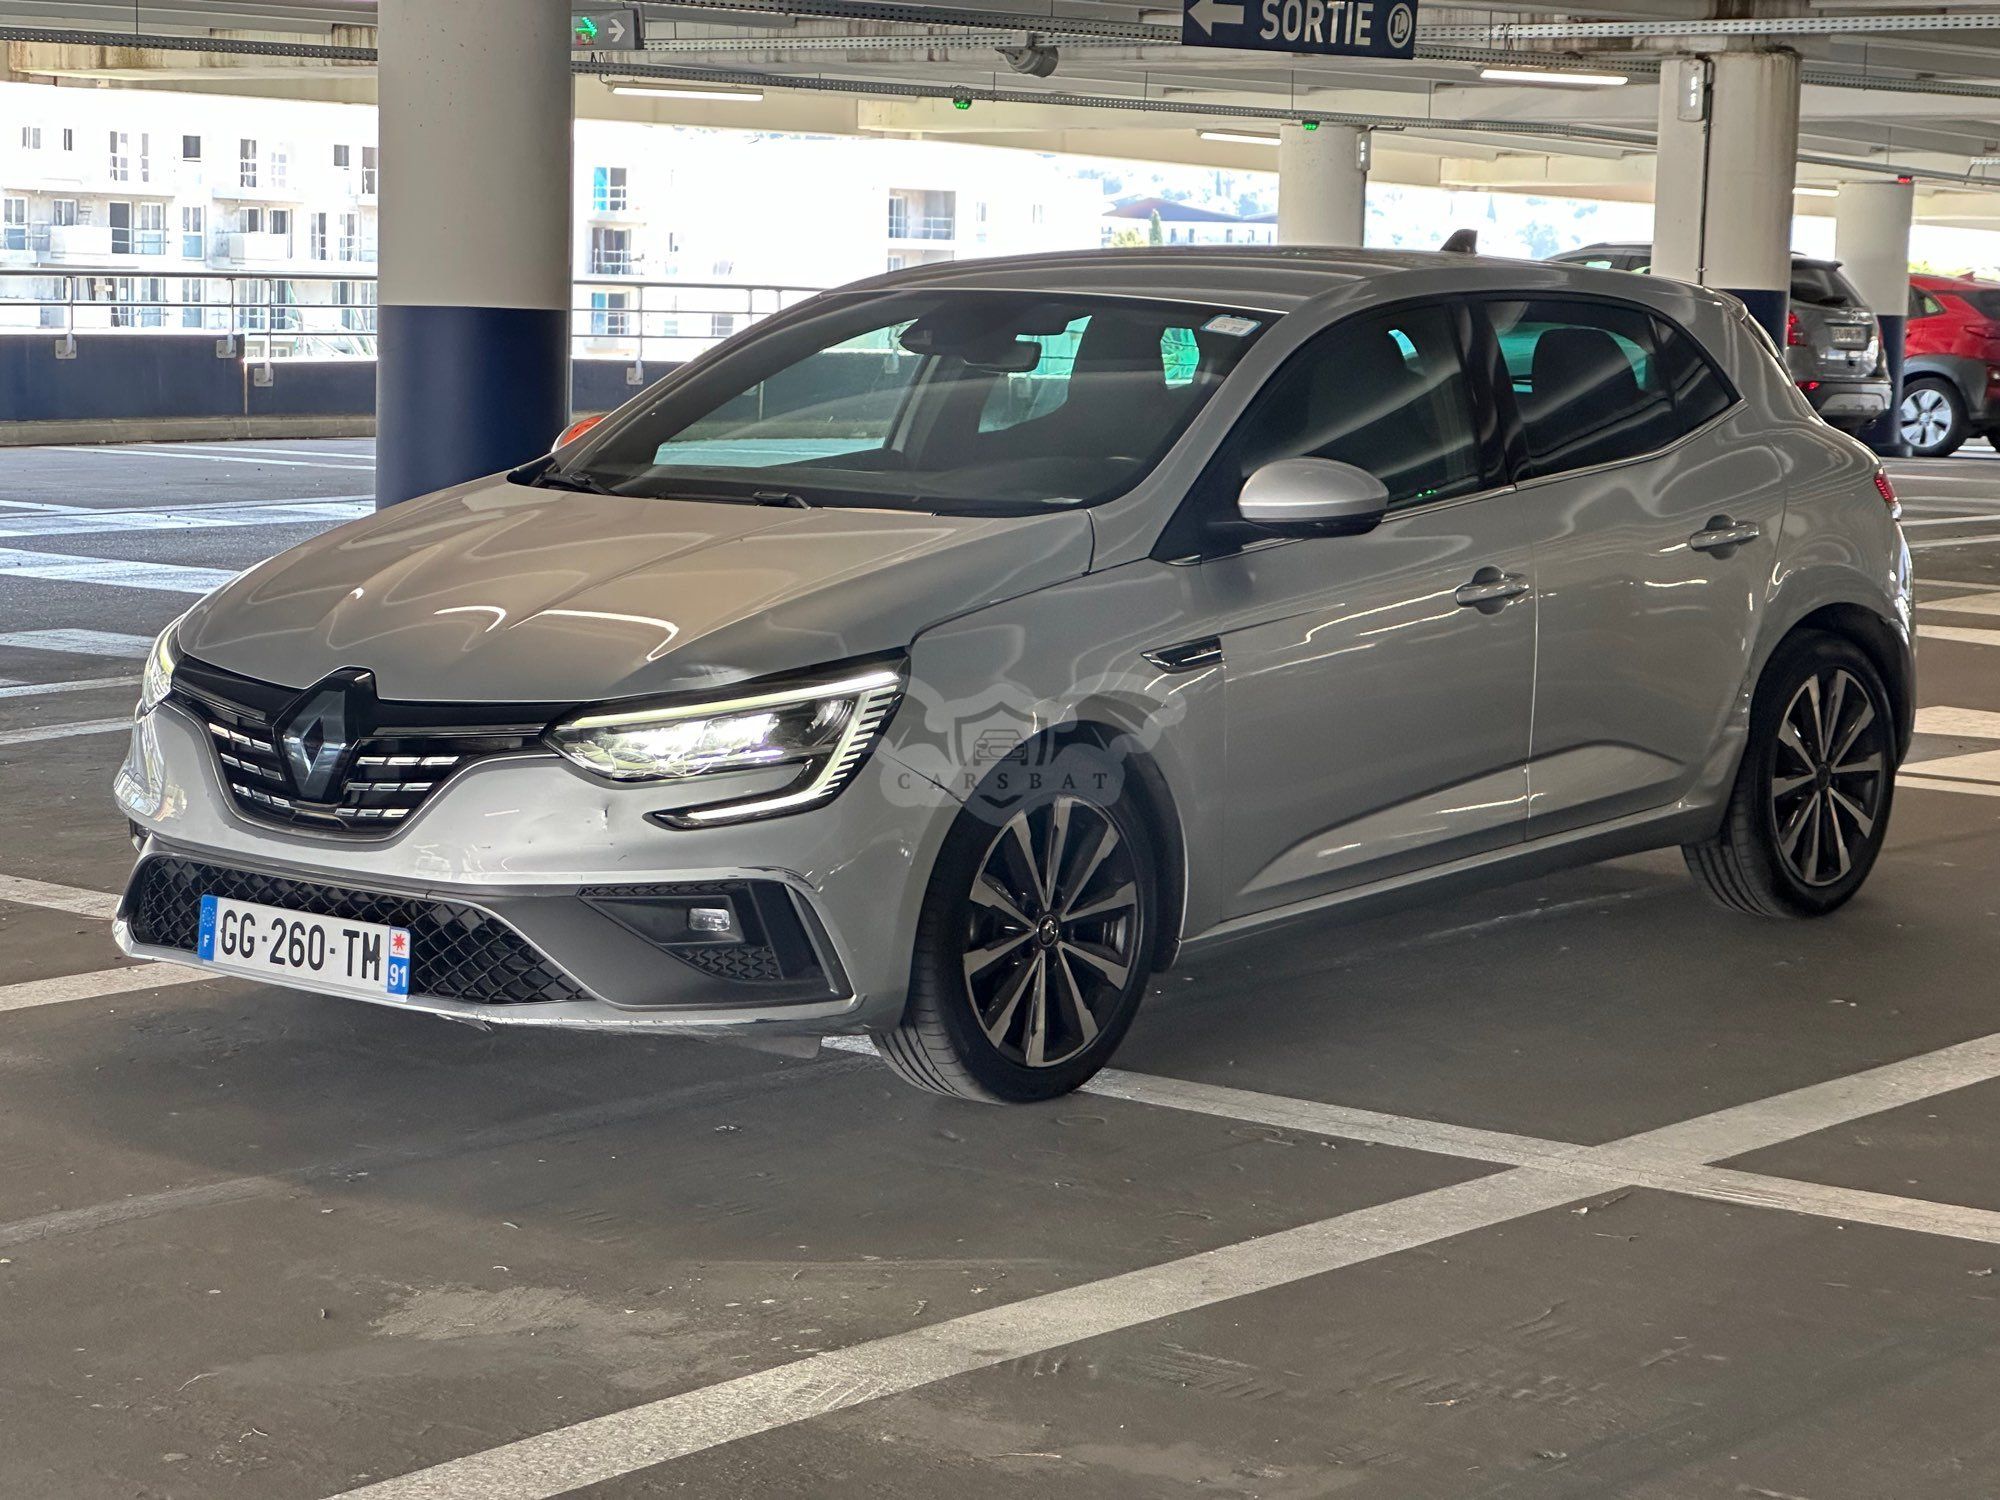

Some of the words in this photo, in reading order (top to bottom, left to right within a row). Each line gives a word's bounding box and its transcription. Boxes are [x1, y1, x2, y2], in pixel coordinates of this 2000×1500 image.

[1259, 0, 1374, 46] SORTIE
[203, 934, 210, 947] F
[389, 963, 408, 988] 91
